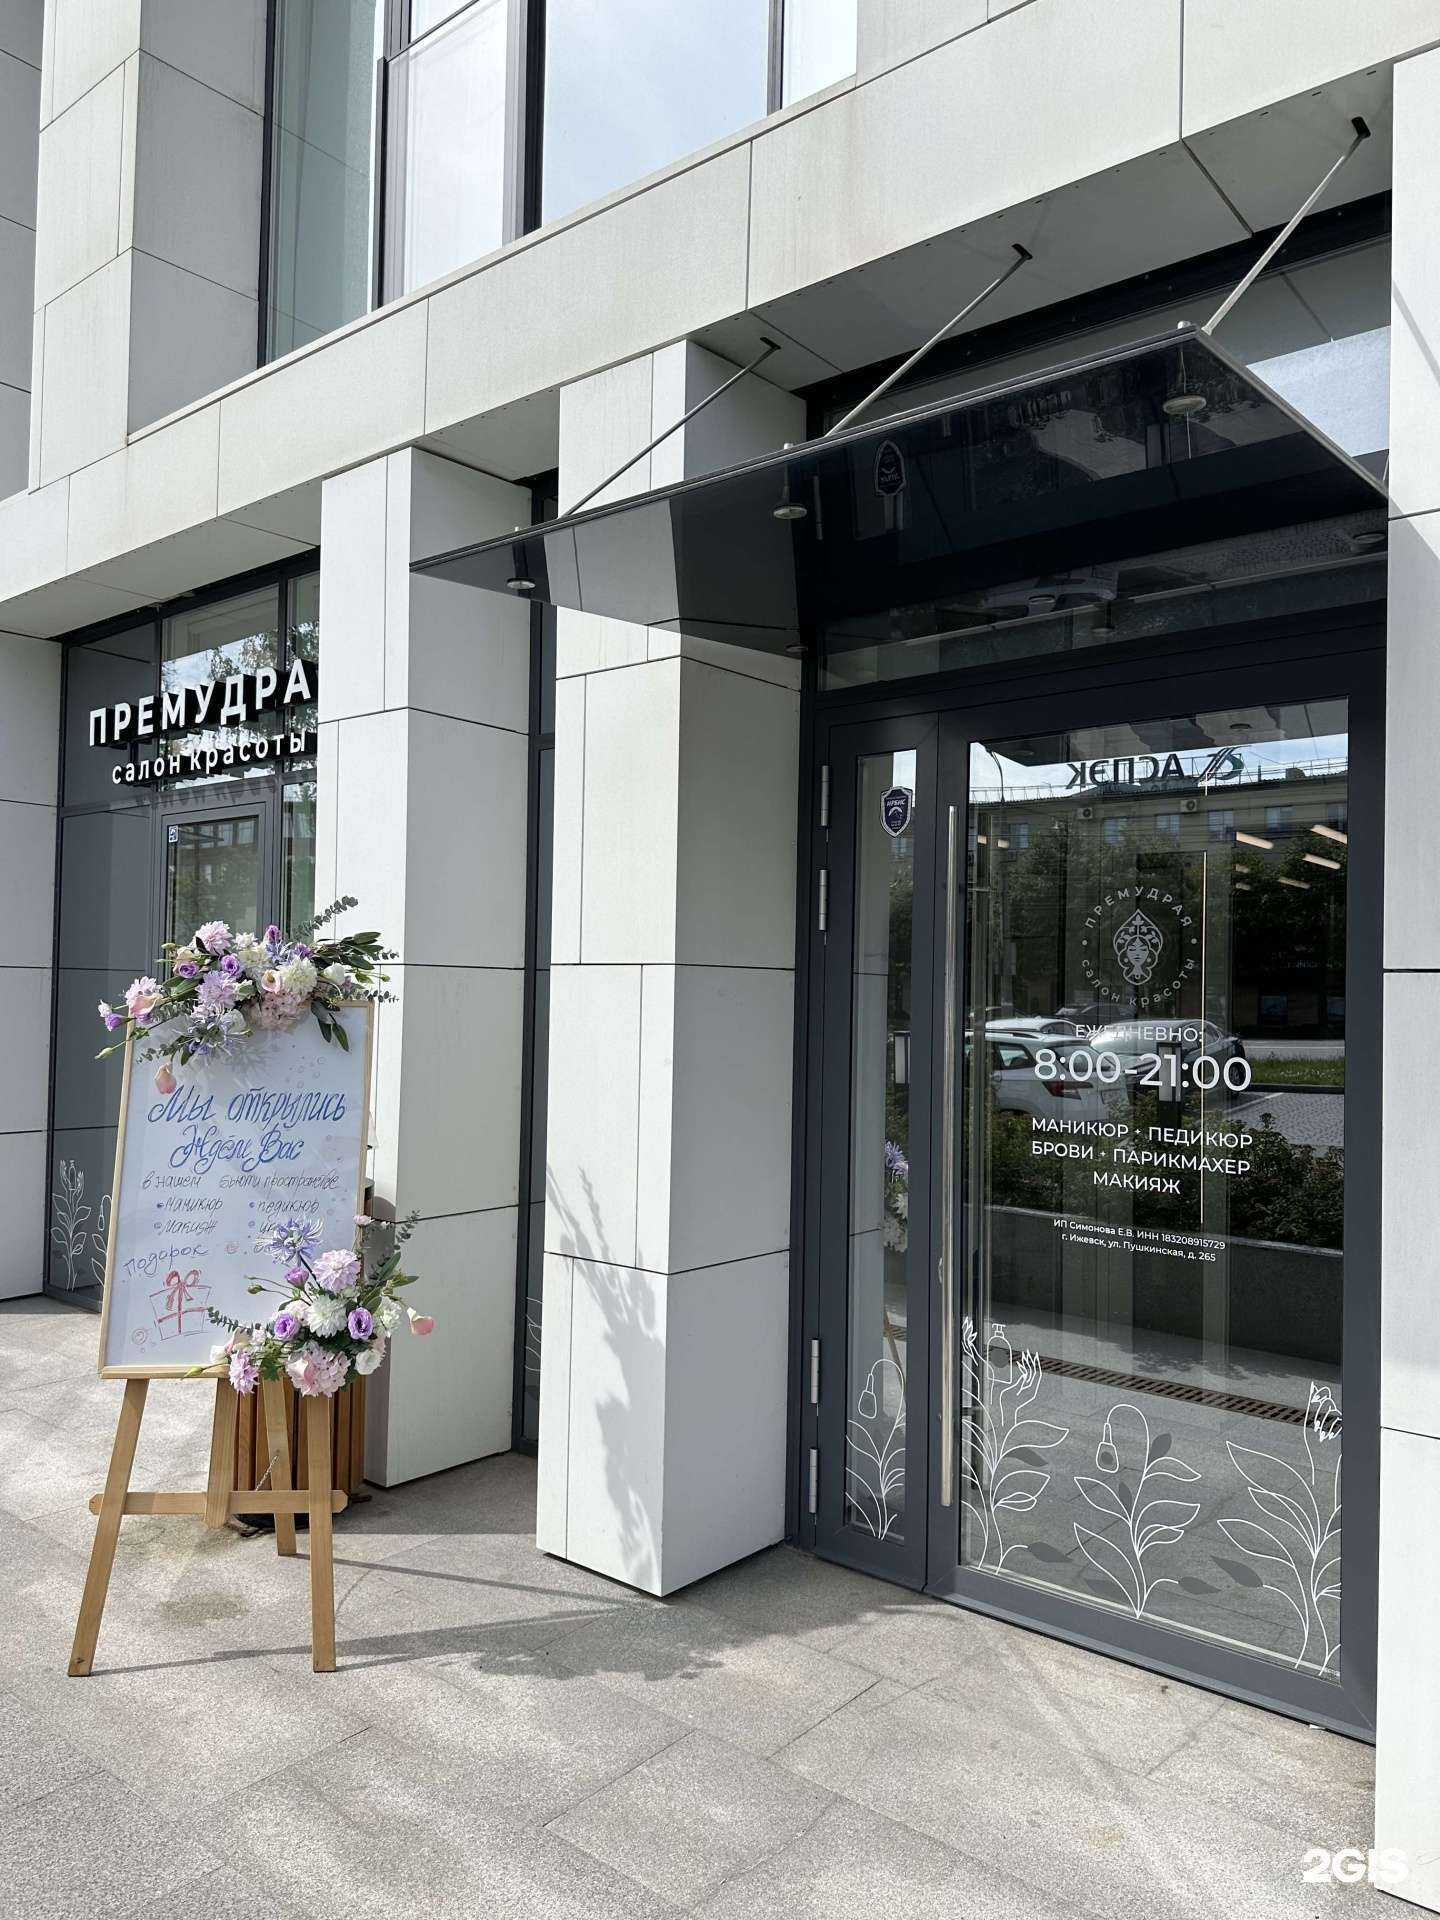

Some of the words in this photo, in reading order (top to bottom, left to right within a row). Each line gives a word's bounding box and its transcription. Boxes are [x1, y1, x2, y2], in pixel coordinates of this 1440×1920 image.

[89, 659, 312, 747] ПРЕМУДРА
[112, 754, 180, 784] салон
[190, 731, 305, 774] красоты
[1085, 886, 1192, 928] ПРЕМУДРАЯ
[1082, 960, 1120, 1002] салон
[1129, 959, 1195, 1008] красоты
[1034, 1048, 1252, 1091] 8:00-21:00
[148, 1084, 216, 1123] Мы
[227, 1087, 347, 1130] открылись
[1032, 1118, 1129, 1138] МАНИКЮР
[1149, 1127, 1253, 1149] ПЕДИКЮР
[1032, 1141, 1094, 1160] БРОВИ
[1113, 1149, 1251, 1175] ПАРИКМАХЕР
[1093, 1171, 1181, 1195] МАКИЯЖ
[1053, 1219, 1068, 1228] ИП
[1069, 1221, 1116, 1235] Симонова
[1118, 1229, 1135, 1238] Е.В.
[1137, 1231, 1159, 1241] ИНН
[1161, 1233, 1226, 1250] 183208915729
[1069, 1234, 1107, 1247] Ижевск,
[1108, 1240, 1121, 1249] ул.
[1123, 1241, 1186, 1260] Пушкинская,
[1187, 1251, 1197, 1260] д.
[1198, 1251, 1217, 1262] 265
